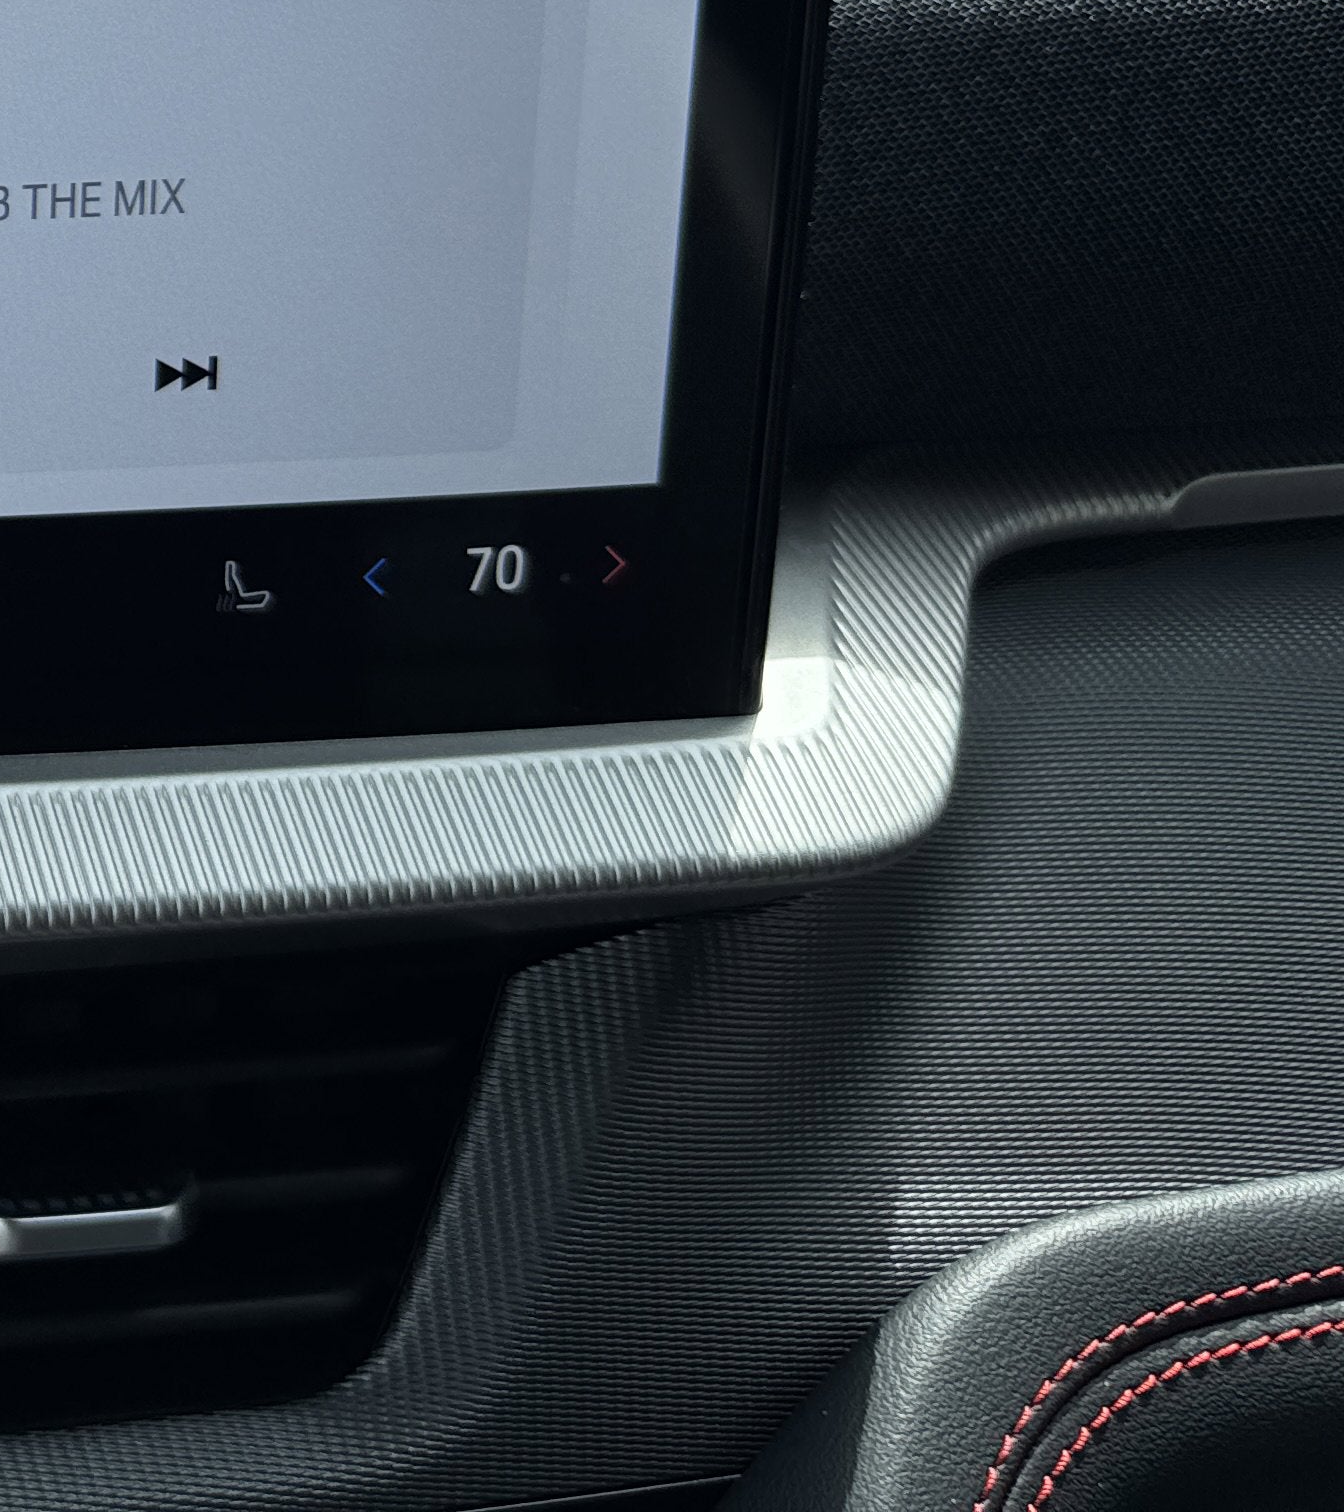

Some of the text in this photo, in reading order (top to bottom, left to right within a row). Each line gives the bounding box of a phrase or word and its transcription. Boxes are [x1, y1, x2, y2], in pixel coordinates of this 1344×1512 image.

[21, 181, 102, 221] THE
[113, 178, 187, 218] MIX
[466, 543, 527, 593] 70
